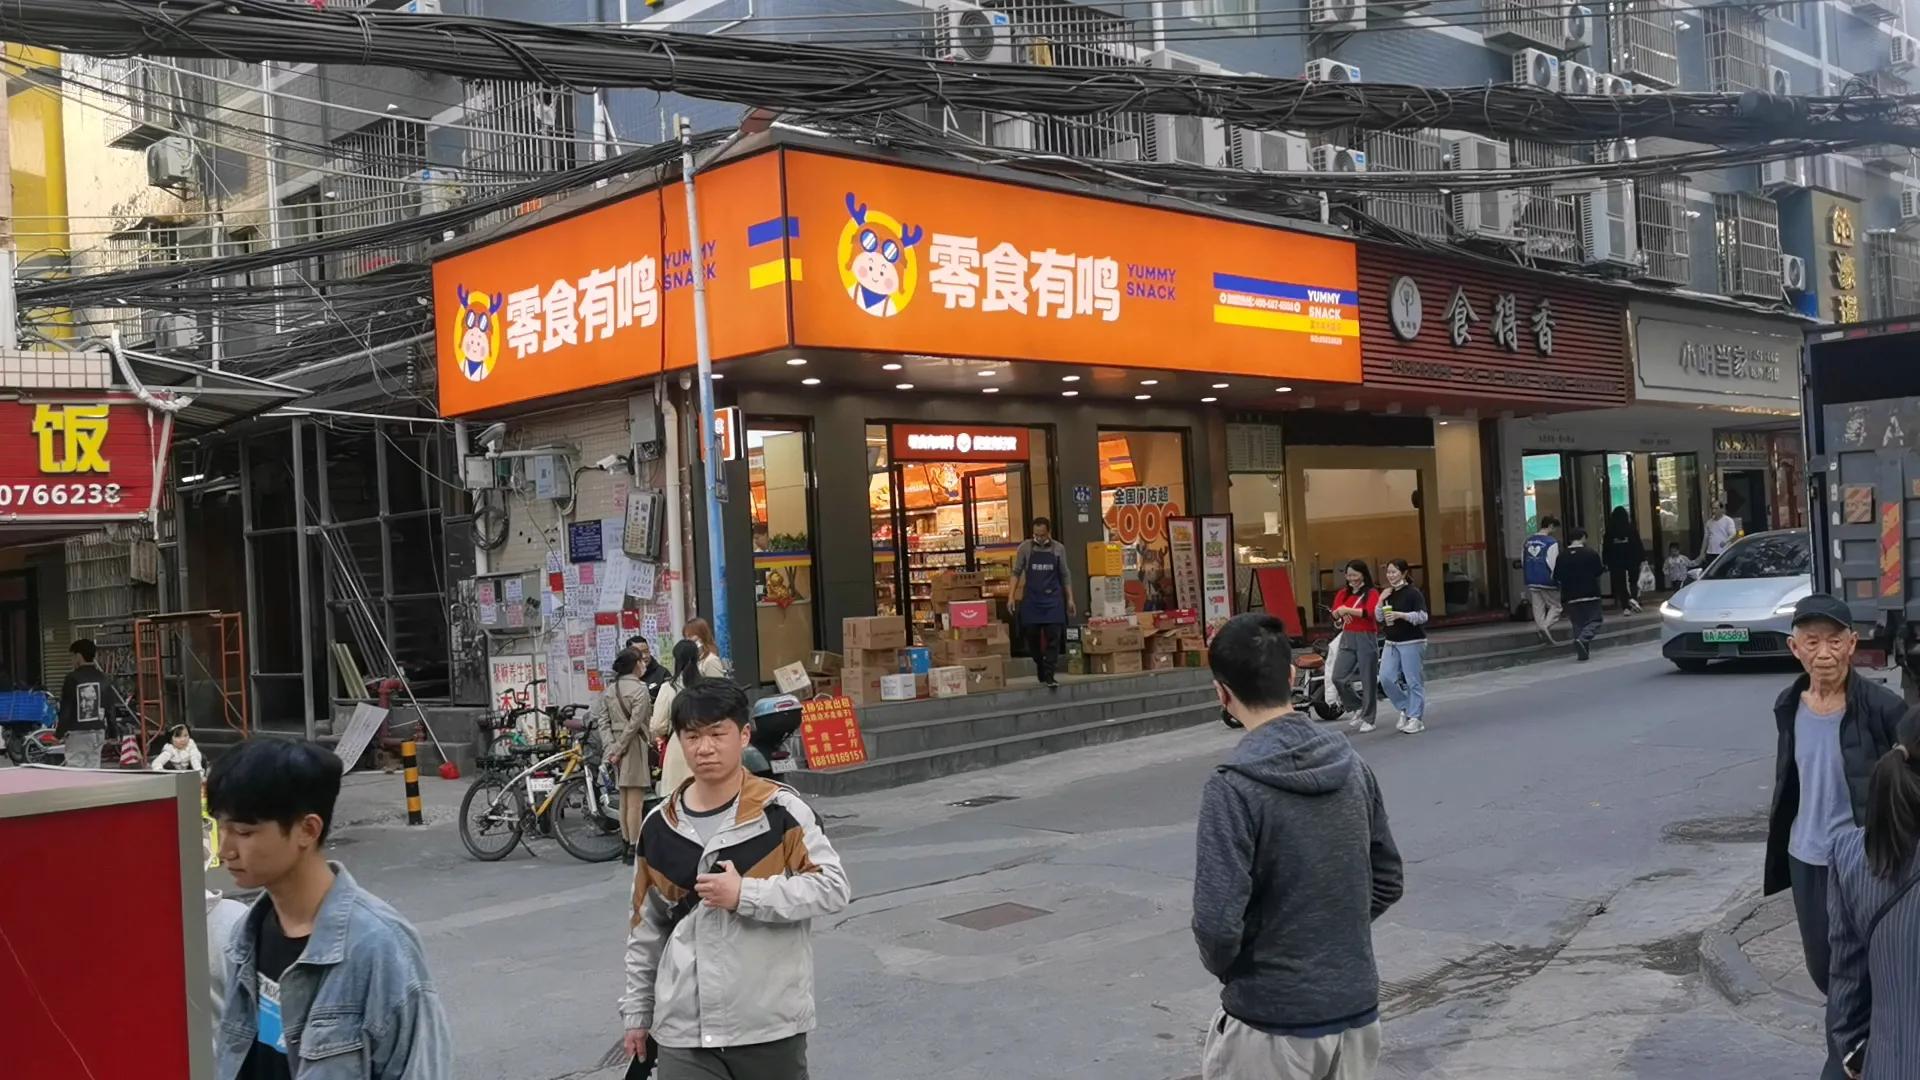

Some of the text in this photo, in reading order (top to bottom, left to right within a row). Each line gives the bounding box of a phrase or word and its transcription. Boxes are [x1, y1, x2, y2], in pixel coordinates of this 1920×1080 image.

[664, 262, 716, 290] SNAK
[929, 232, 1120, 322] 零食有鸣
[1127, 264, 1176, 284] YUMMY
[1127, 281, 1175, 301] SNACK
[1307, 289, 1341, 304] YUMMY
[506, 254, 656, 360] 零食有鸣
[1308, 306, 1341, 320] SNACK
[1447, 285, 1556, 356] 食得香
[32, 404, 111, 473] 饭
[1115, 487, 1168, 504] 全国门店超
